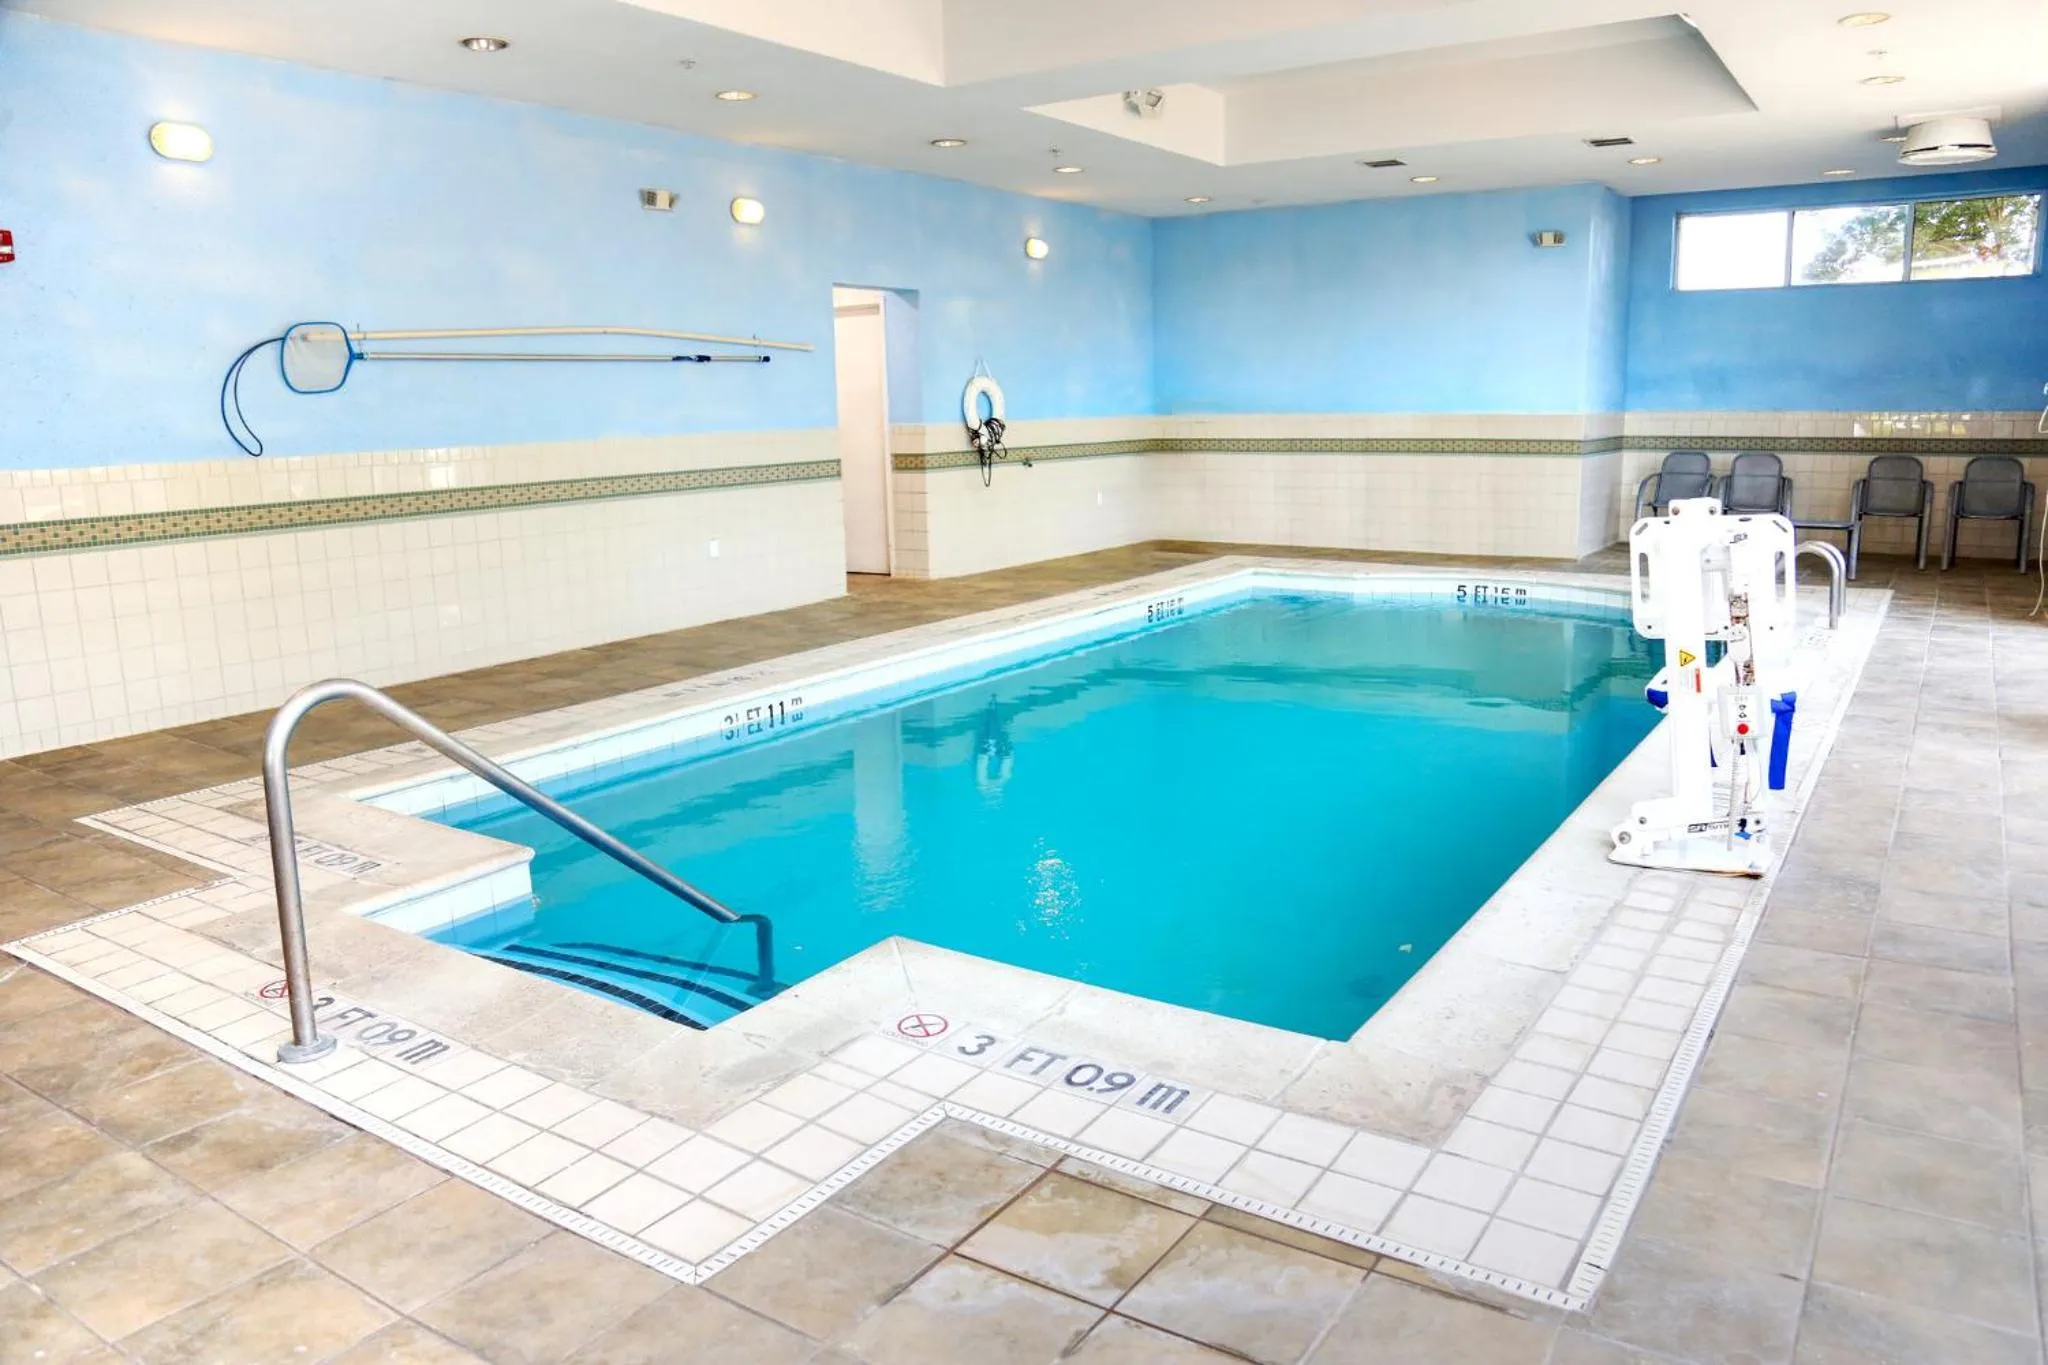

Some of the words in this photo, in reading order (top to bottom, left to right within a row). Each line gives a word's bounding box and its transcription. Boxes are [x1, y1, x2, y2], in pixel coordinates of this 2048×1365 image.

[1457, 585, 1467, 602] 5
[317, 1006, 379, 1030] FT
[395, 1038, 450, 1065] m
[957, 1034, 997, 1056] 3
[1004, 1047, 1069, 1076] FT
[1063, 1063, 1137, 1094] 0.9
[1136, 1081, 1191, 1114] m
